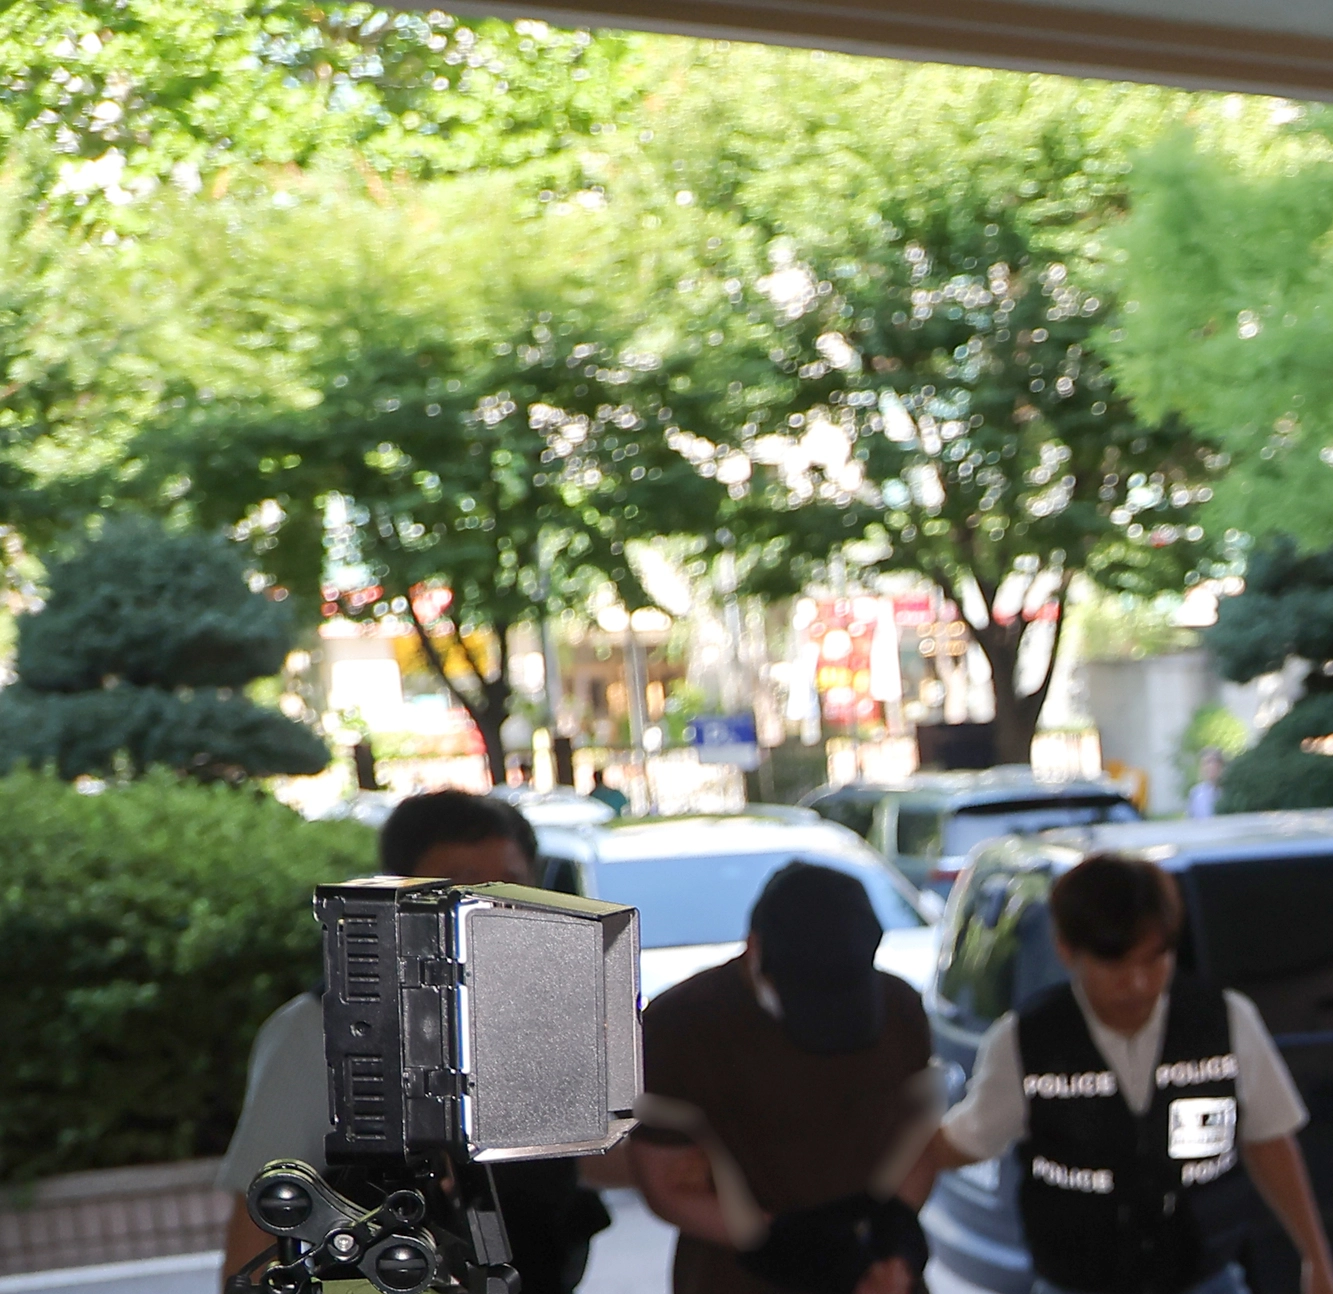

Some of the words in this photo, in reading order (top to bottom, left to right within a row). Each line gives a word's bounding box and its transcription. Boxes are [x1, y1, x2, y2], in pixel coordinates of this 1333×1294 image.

[1023, 1072, 1118, 1099] POLICE
[1156, 1053, 1239, 1090] POLICE
[1032, 1155, 1114, 1194] POLICE
